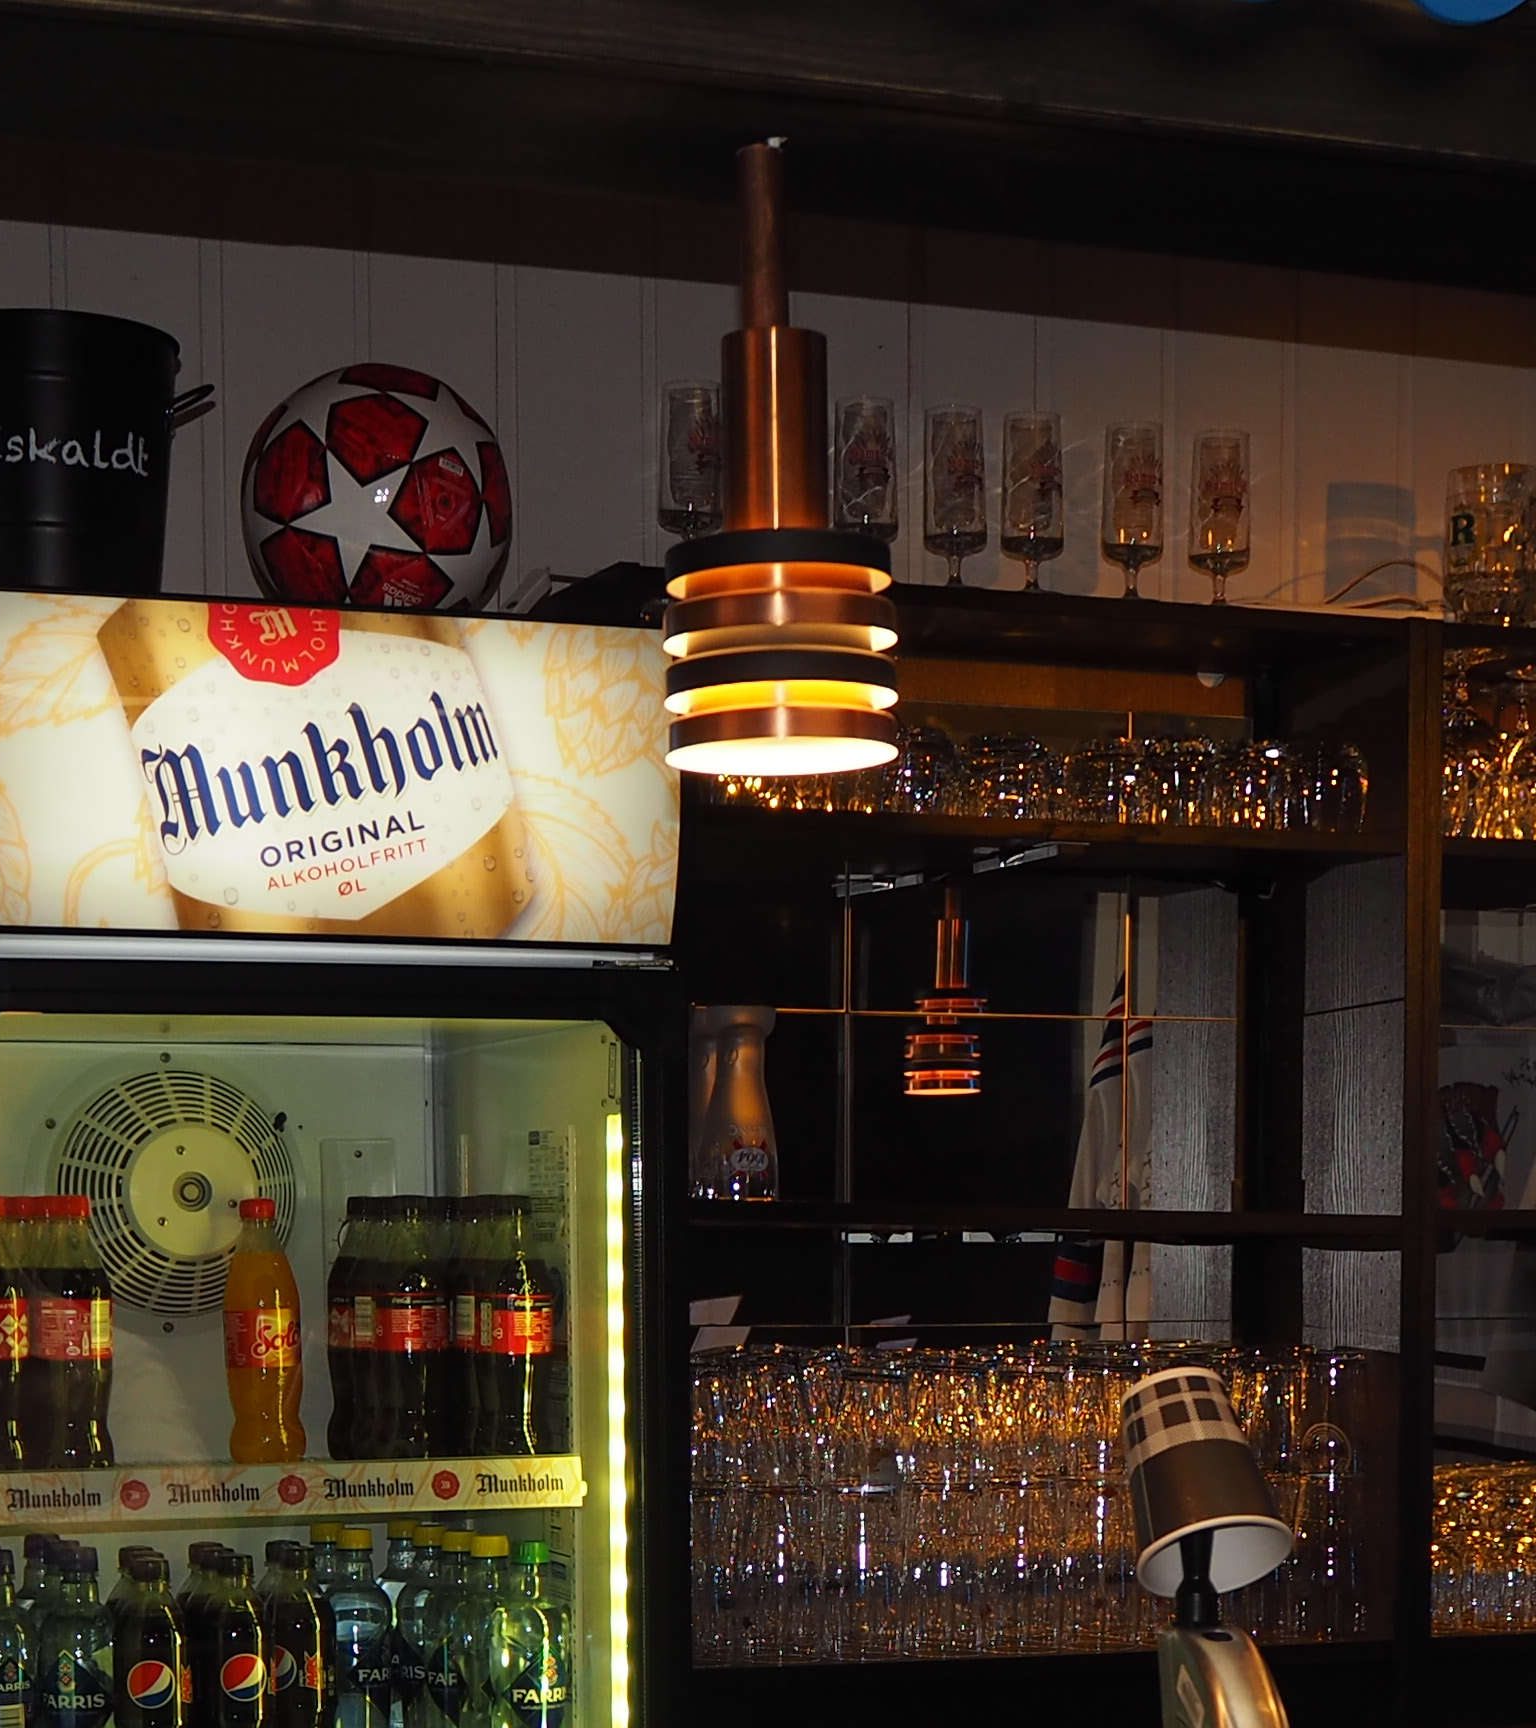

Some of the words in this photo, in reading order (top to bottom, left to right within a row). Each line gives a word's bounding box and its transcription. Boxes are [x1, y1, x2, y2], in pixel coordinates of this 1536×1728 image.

[382, 582, 422, 605] adidas
[141, 691, 498, 856] Munkholm
[260, 811, 425, 867] ORIGINAL
[267, 839, 428, 891] ALKOHOLFRITT
[338, 877, 367, 897] ØL
[167, 1482, 261, 1507] Munkholm
[323, 1477, 414, 1500] Munkholm
[476, 1472, 564, 1495] Munkholm
[6, 1488, 102, 1512] Munkholm
